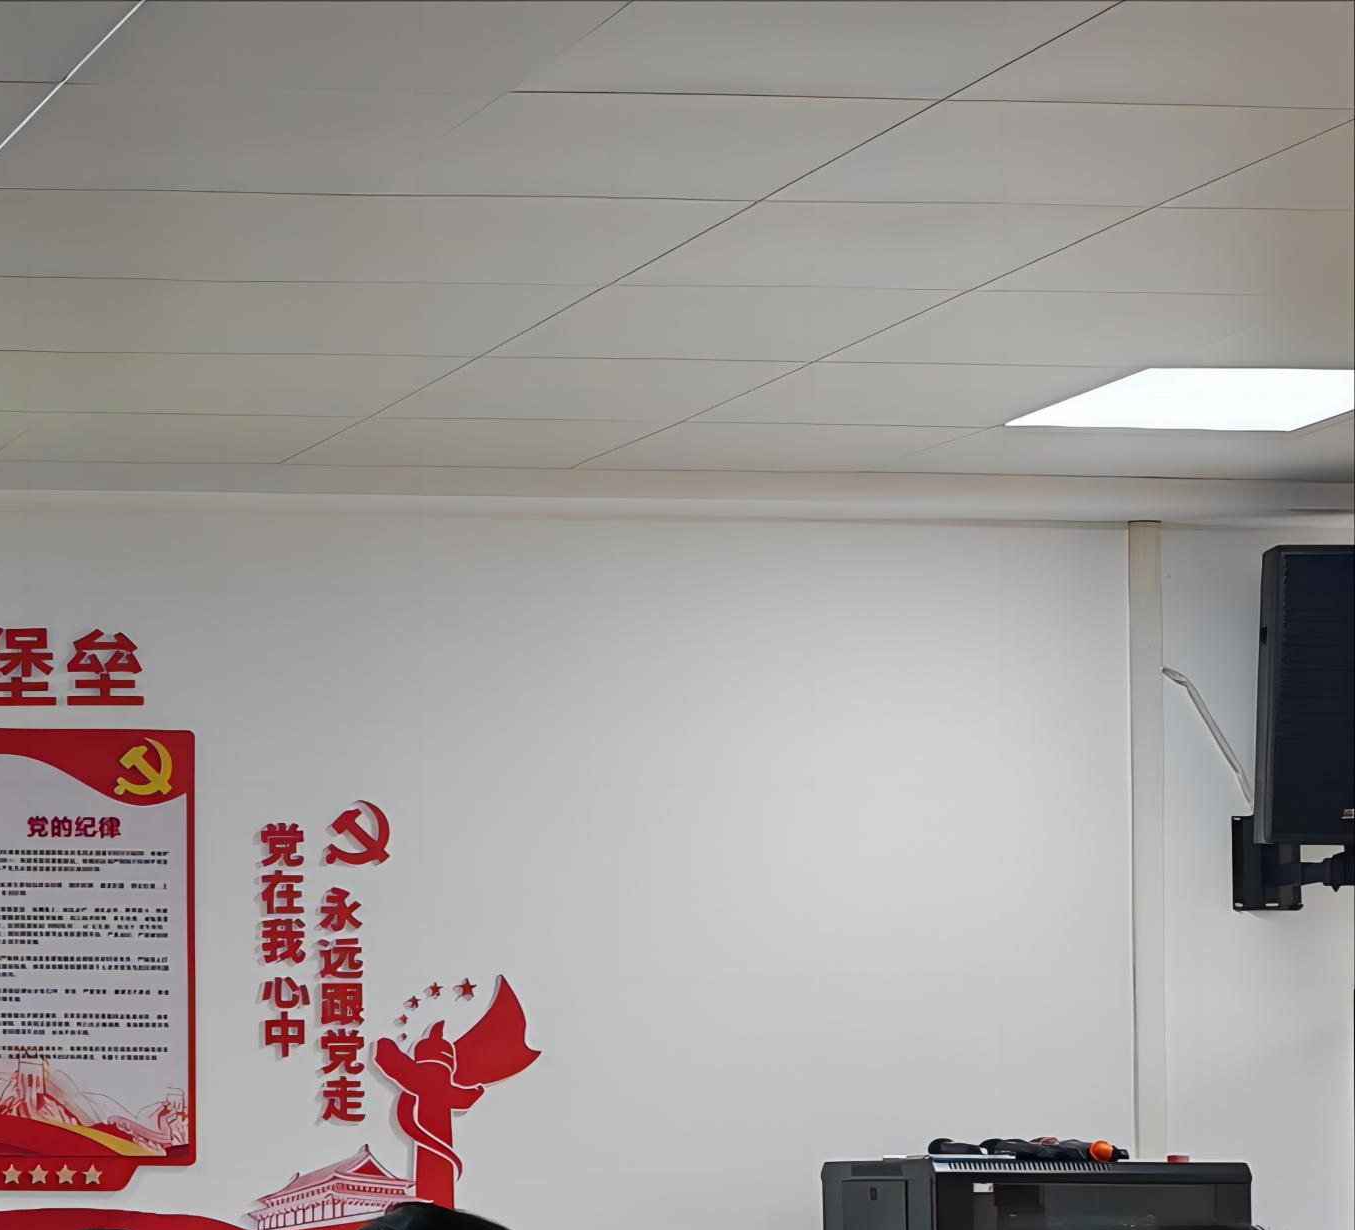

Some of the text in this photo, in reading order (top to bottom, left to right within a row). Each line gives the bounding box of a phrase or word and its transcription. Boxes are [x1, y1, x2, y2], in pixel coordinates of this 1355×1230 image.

[26, 816, 122, 839] 党的纪律
[260, 822, 311, 1058] 党在我心中
[319, 886, 367, 1123] 永远跟党走
